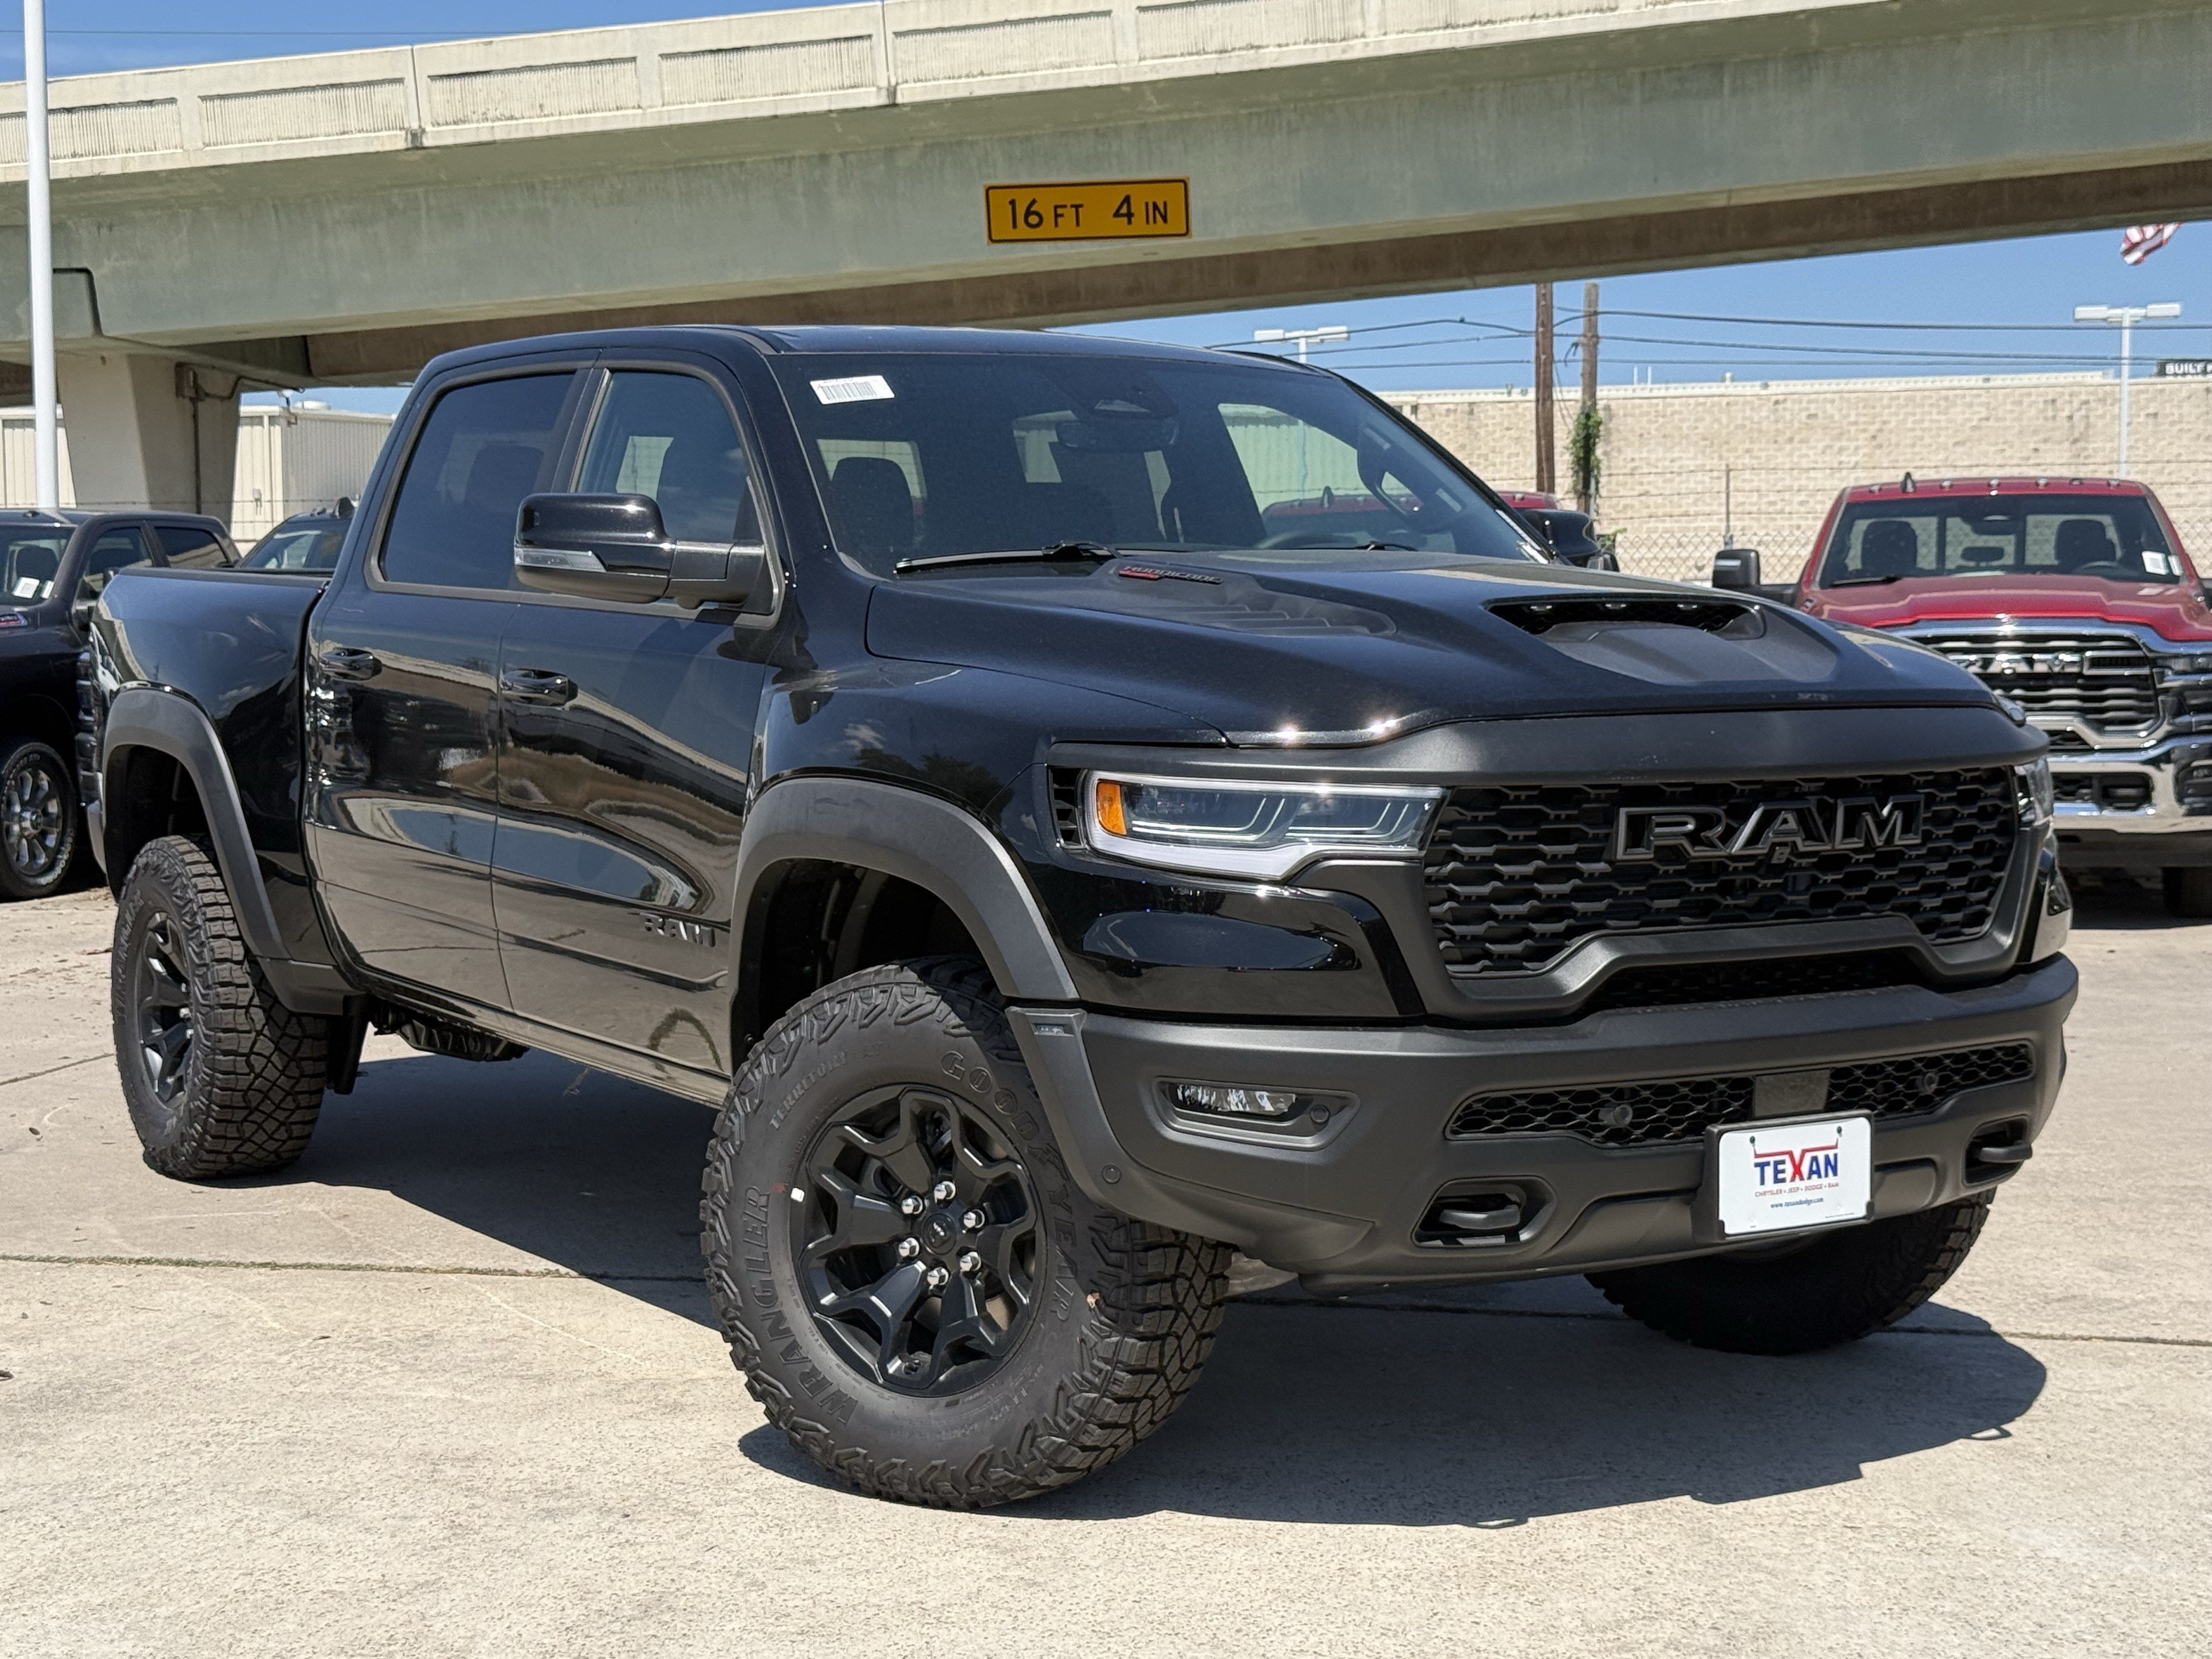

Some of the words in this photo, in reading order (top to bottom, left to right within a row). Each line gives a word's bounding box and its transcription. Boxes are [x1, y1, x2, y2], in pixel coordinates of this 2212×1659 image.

[1008, 198, 1044, 229] 16
[1053, 204, 1084, 228] FT
[1112, 194, 1135, 225] 4
[1145, 200, 1168, 225] IN
[1613, 794, 1923, 860] RAM
[768, 1049, 848, 1130] TERRITORY
[1754, 1150, 1838, 1186] TEXAN
[742, 1184, 859, 1425] WRANGLER
